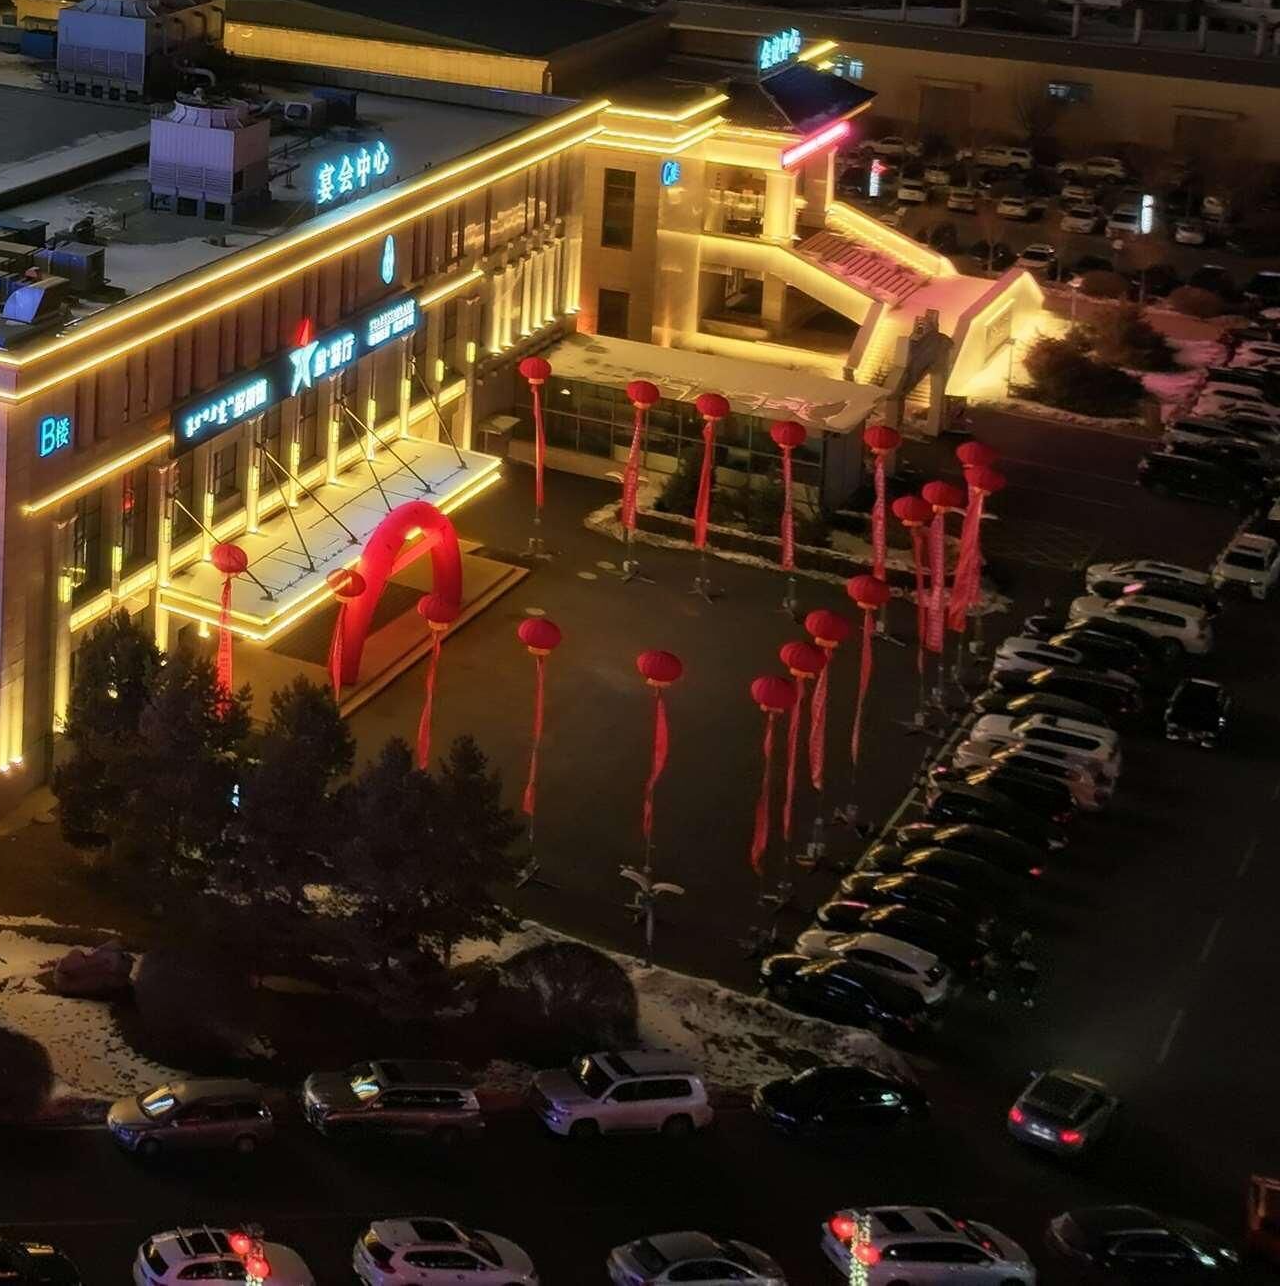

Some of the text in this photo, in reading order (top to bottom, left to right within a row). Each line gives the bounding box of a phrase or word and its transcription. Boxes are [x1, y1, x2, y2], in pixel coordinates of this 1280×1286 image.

[317, 140, 390, 204] 宴会中心
[40, 416, 70, 457] B楼
